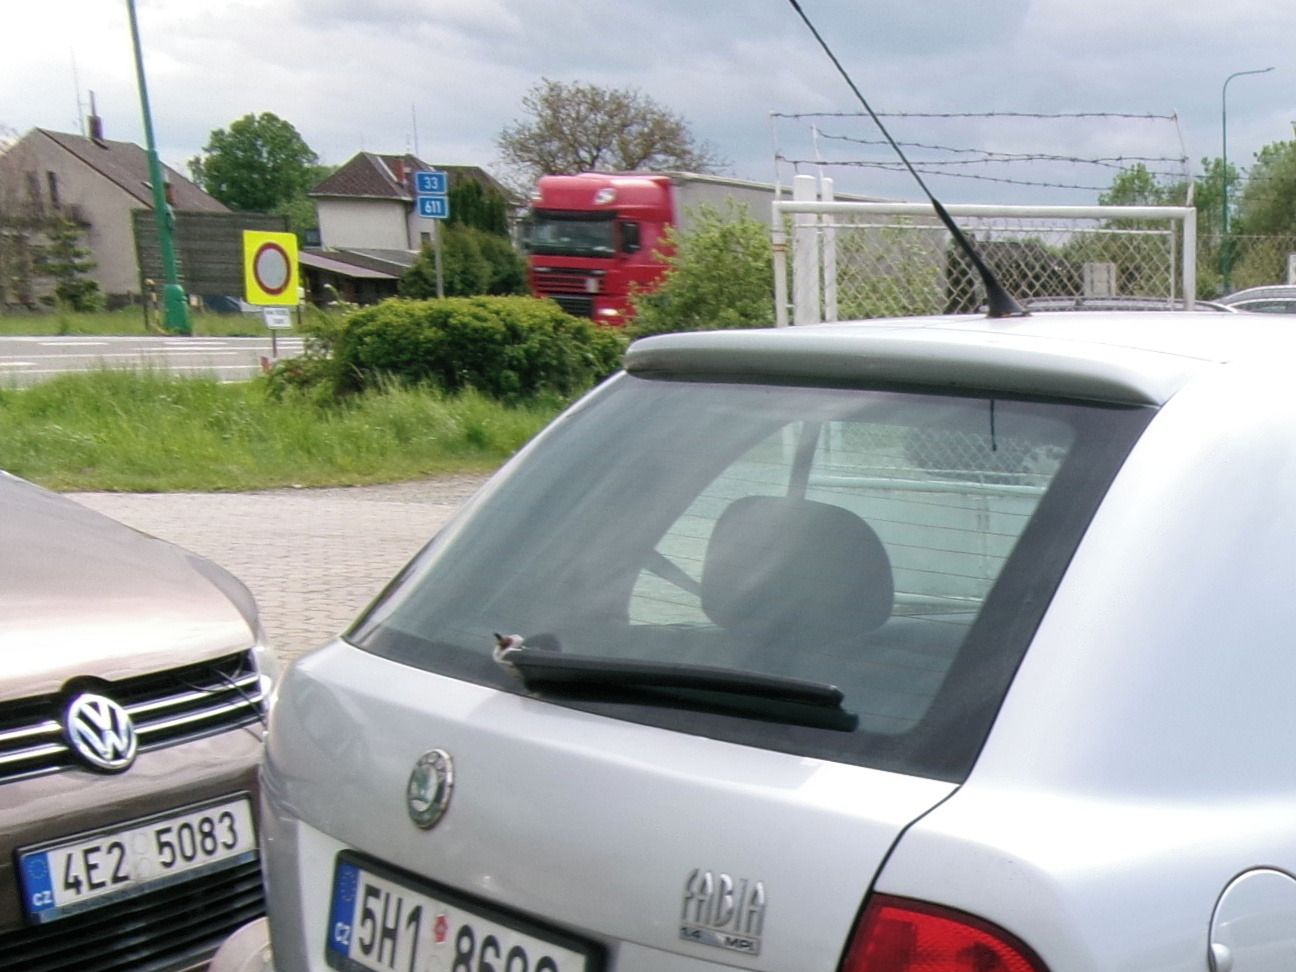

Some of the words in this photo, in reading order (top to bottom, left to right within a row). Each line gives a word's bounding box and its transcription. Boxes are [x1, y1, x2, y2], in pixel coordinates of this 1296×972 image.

[423, 175, 439, 190] 33
[424, 200, 442, 214] 611
[63, 840, 130, 896] 4E2
[154, 810, 239, 869] 5083
[32, 890, 52, 907] CZ
[681, 868, 766, 936] FABIA
[334, 920, 352, 946] CZ
